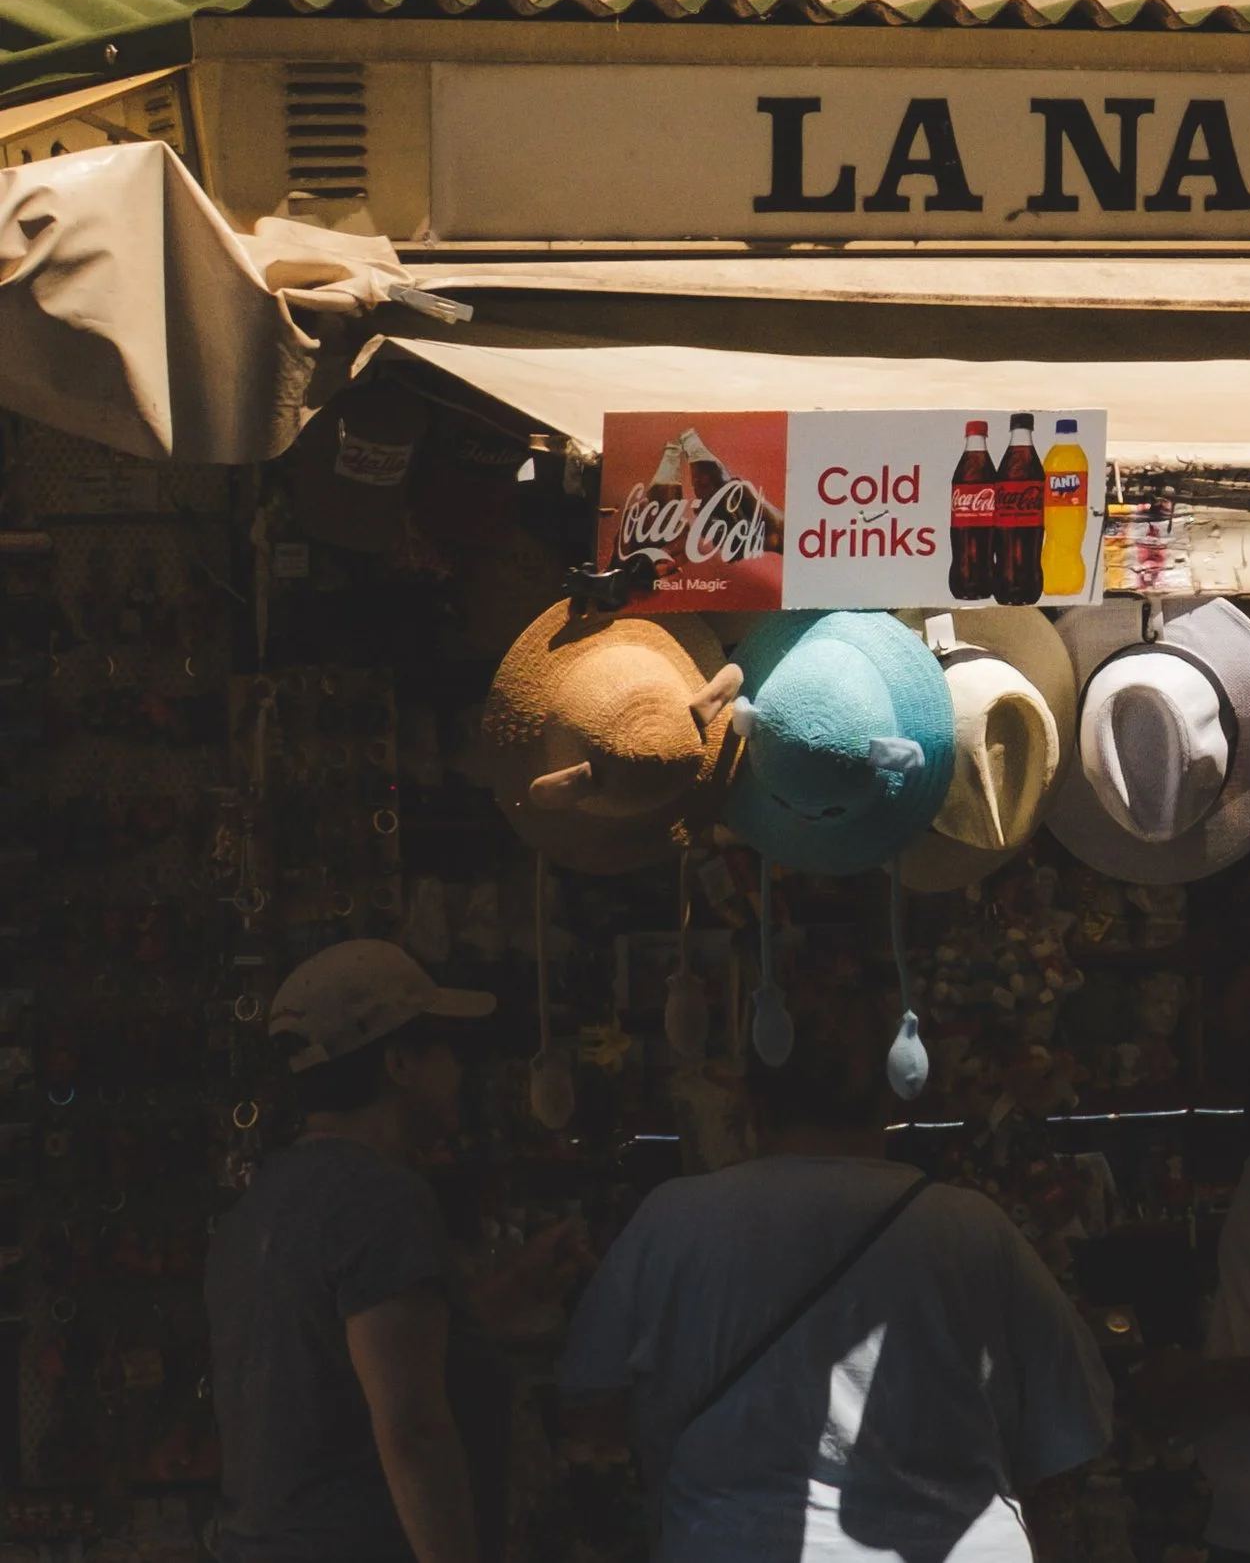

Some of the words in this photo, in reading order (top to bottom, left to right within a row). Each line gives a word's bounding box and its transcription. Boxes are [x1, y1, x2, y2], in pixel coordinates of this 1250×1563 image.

[753, 97, 983, 213] LA
[817, 464, 920, 506] Cold
[618, 480, 766, 563] Coca-Cola
[798, 517, 936, 558] drinks
[653, 578, 683, 590] Real
[686, 578, 727, 592] Magic
